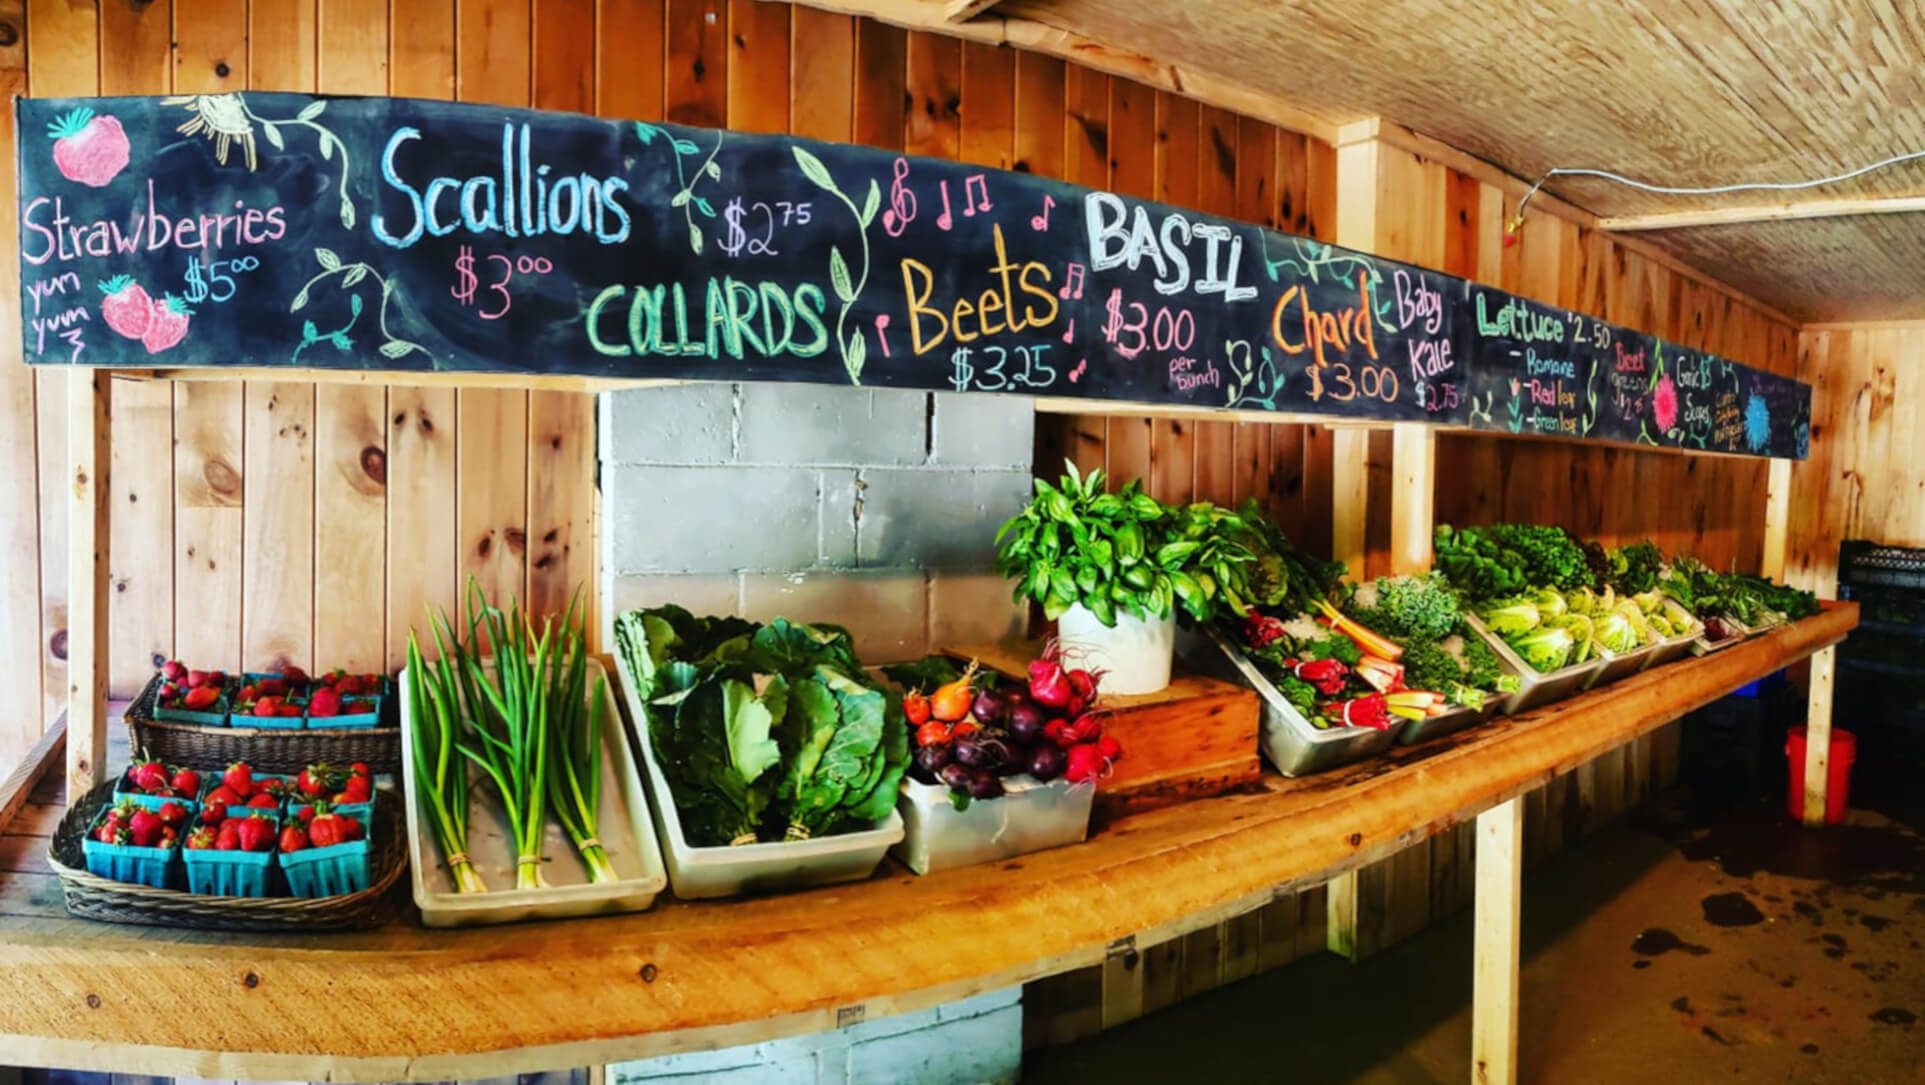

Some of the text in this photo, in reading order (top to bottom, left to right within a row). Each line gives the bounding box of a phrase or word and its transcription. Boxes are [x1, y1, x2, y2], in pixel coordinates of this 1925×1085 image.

[370, 117, 631, 249] Scallions
[22, 177, 286, 264] Strawberries
[1084, 191, 1259, 303] BASIL
[26, 271, 81, 312] yum
[586, 276, 830, 360] COLLARDS
[900, 222, 1059, 357] Beets
[1272, 269, 1379, 368] Chard
[1394, 269, 1443, 334] Baby
[1476, 292, 1565, 343] Lettuce
[31, 306, 91, 354] yum
[1101, 288, 1196, 358] $3.00
[948, 344, 1057, 392] $3.25
[1169, 356, 1196, 373] per
[1305, 363, 1399, 402] $3.00
[1408, 338, 1455, 382] Kale
[1414, 379, 1460, 412] $2.75
